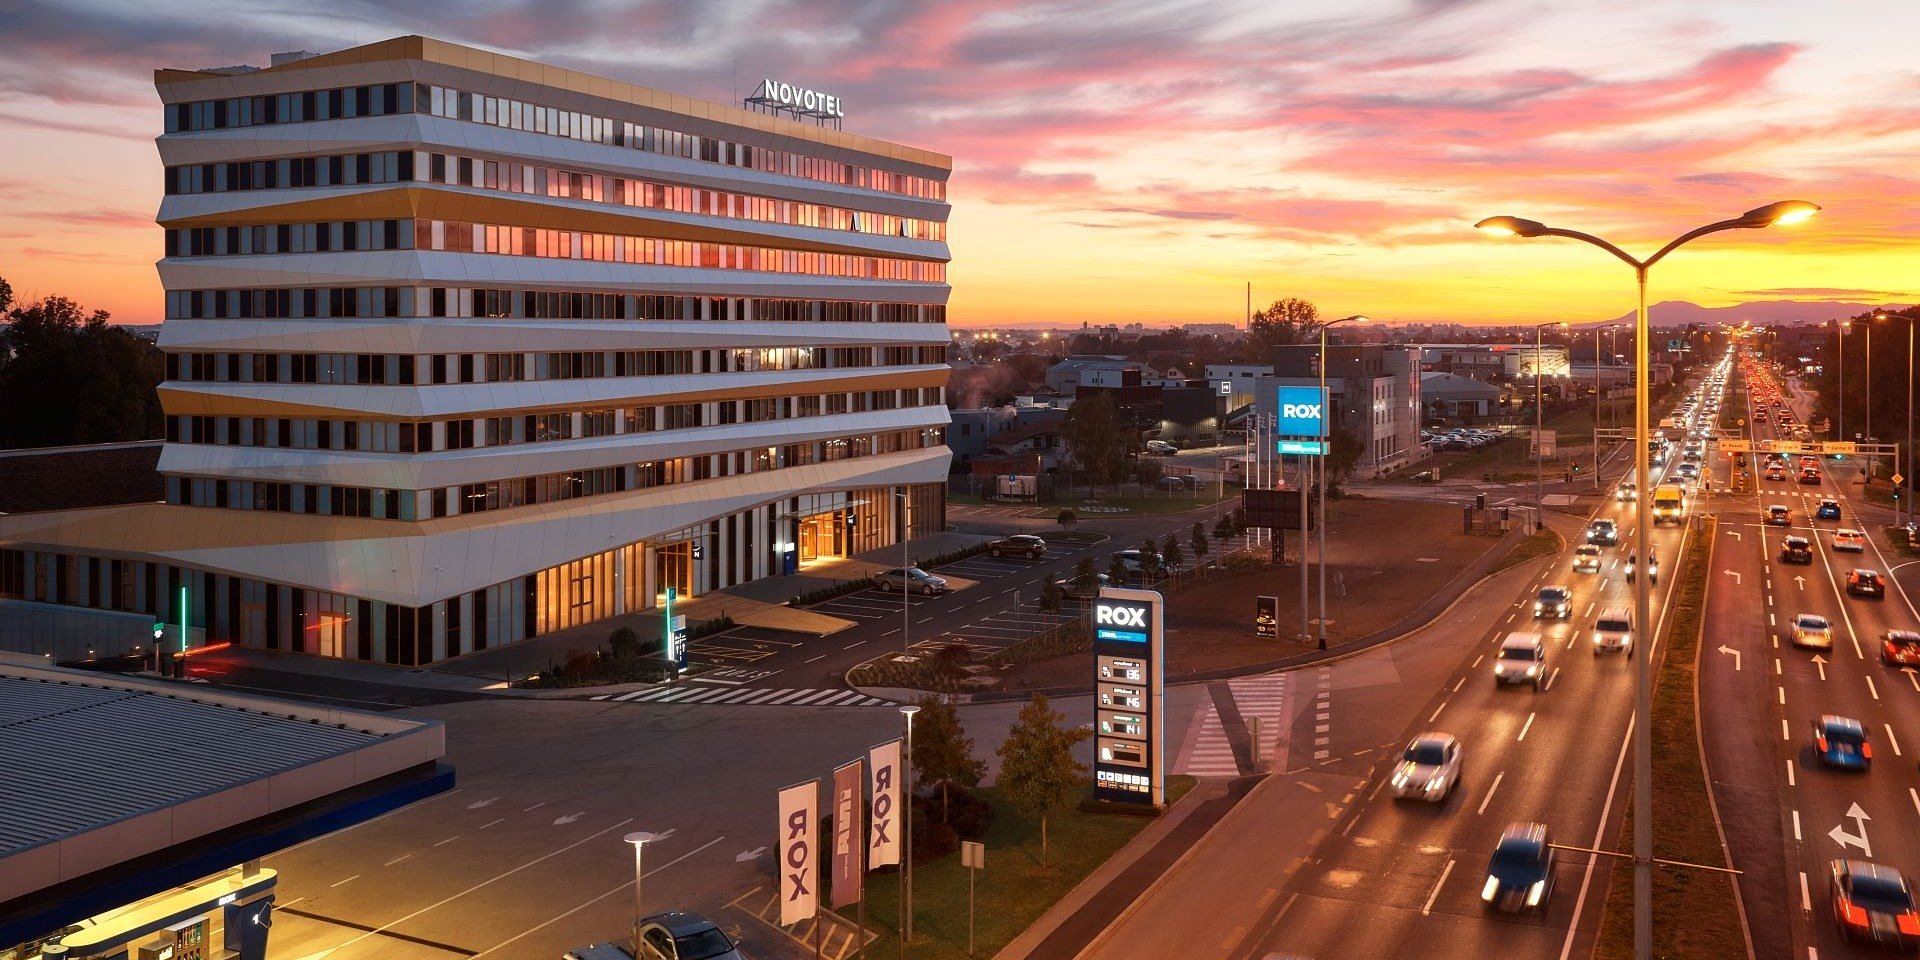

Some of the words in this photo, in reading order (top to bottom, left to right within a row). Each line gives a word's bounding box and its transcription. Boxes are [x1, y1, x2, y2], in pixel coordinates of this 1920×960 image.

[764, 78, 844, 117] NOVOTEL
[1283, 404, 1321, 419] ROX
[670, 589, 676, 597] P
[1097, 605, 1146, 627] ROX
[1127, 669, 1140, 680] 136
[1127, 697, 1140, 708] 146
[1127, 724, 1140, 735] 141
[252, 913, 259, 925] 1
